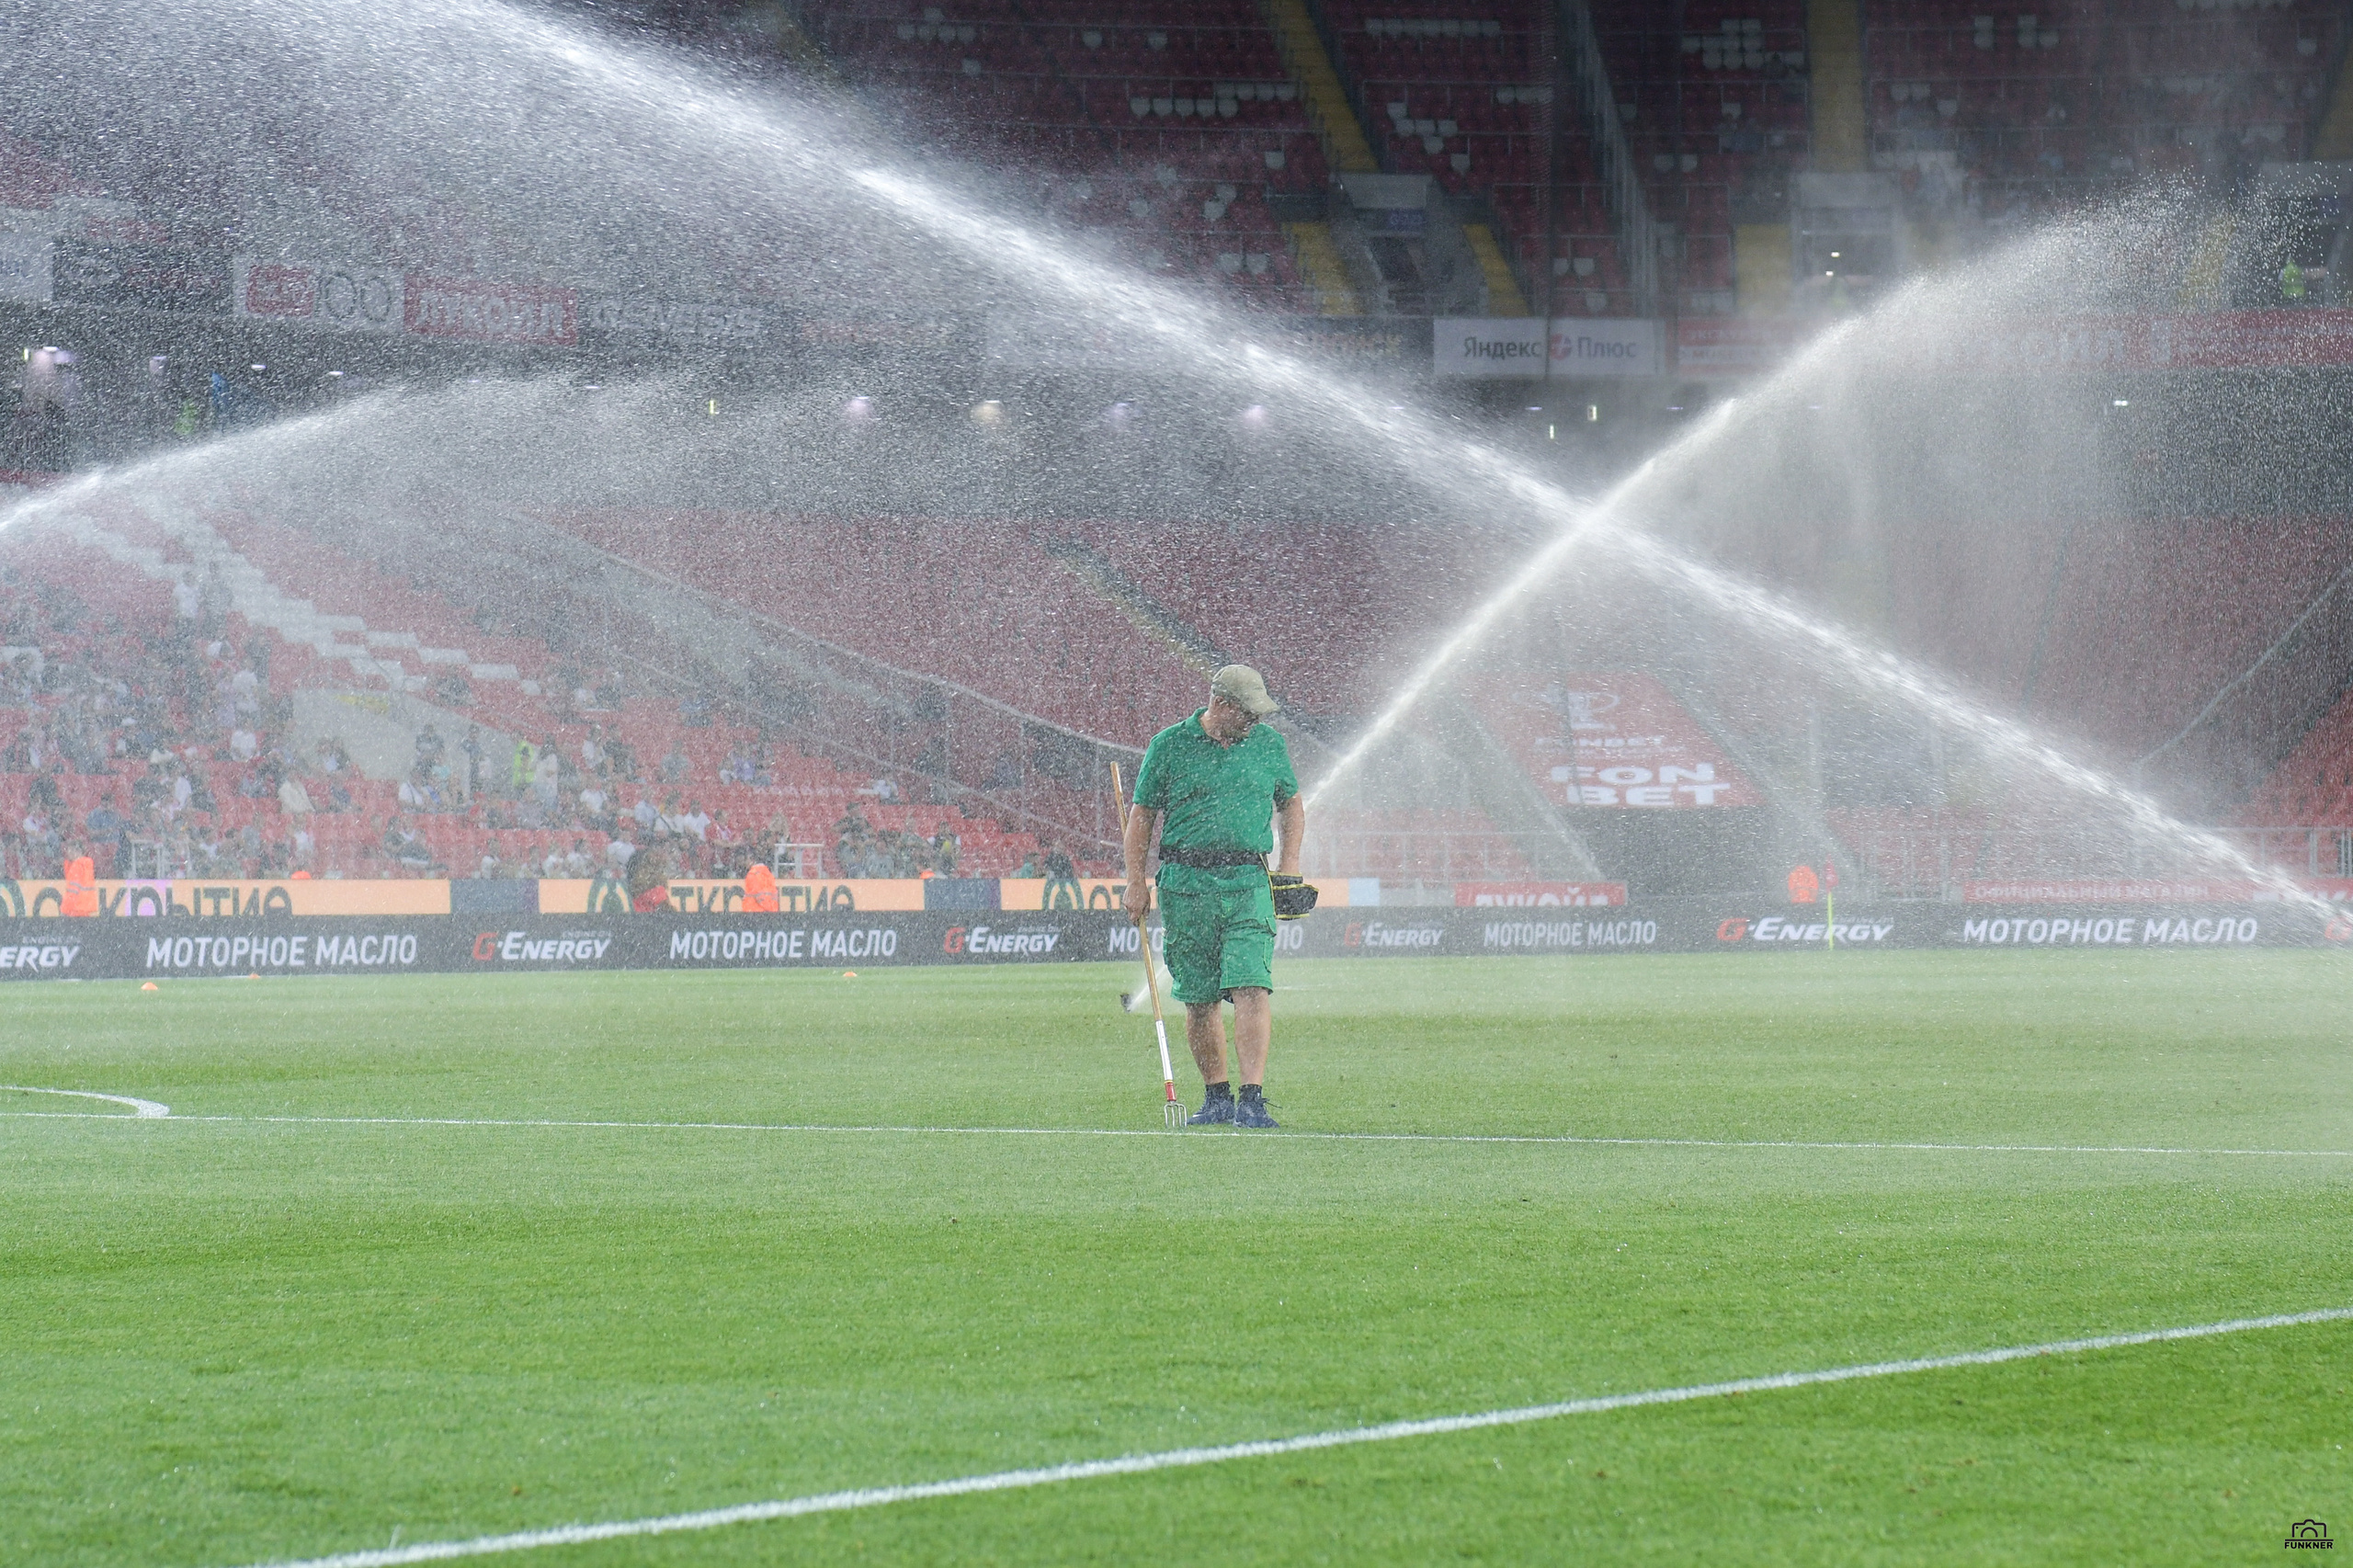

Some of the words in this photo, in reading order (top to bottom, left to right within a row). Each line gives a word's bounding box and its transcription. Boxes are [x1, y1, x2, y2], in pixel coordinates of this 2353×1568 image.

[1463, 336, 1542, 360] Яндекс
[1577, 336, 1637, 359] Плюс
[1565, 782, 1732, 806] BET
[1483, 921, 1581, 948] МОТОРНОЕ
[1587, 920, 1655, 946] МАСЛО
[1963, 919, 2134, 943] МОТОРНОЕ
[2143, 918, 2258, 943] МАСЛО
[146, 937, 307, 968] МОТОРНОЕ
[315, 935, 417, 964] МАСЛО
[669, 930, 803, 960] МОТОРНОЕ
[811, 929, 897, 958] МАСЛО
